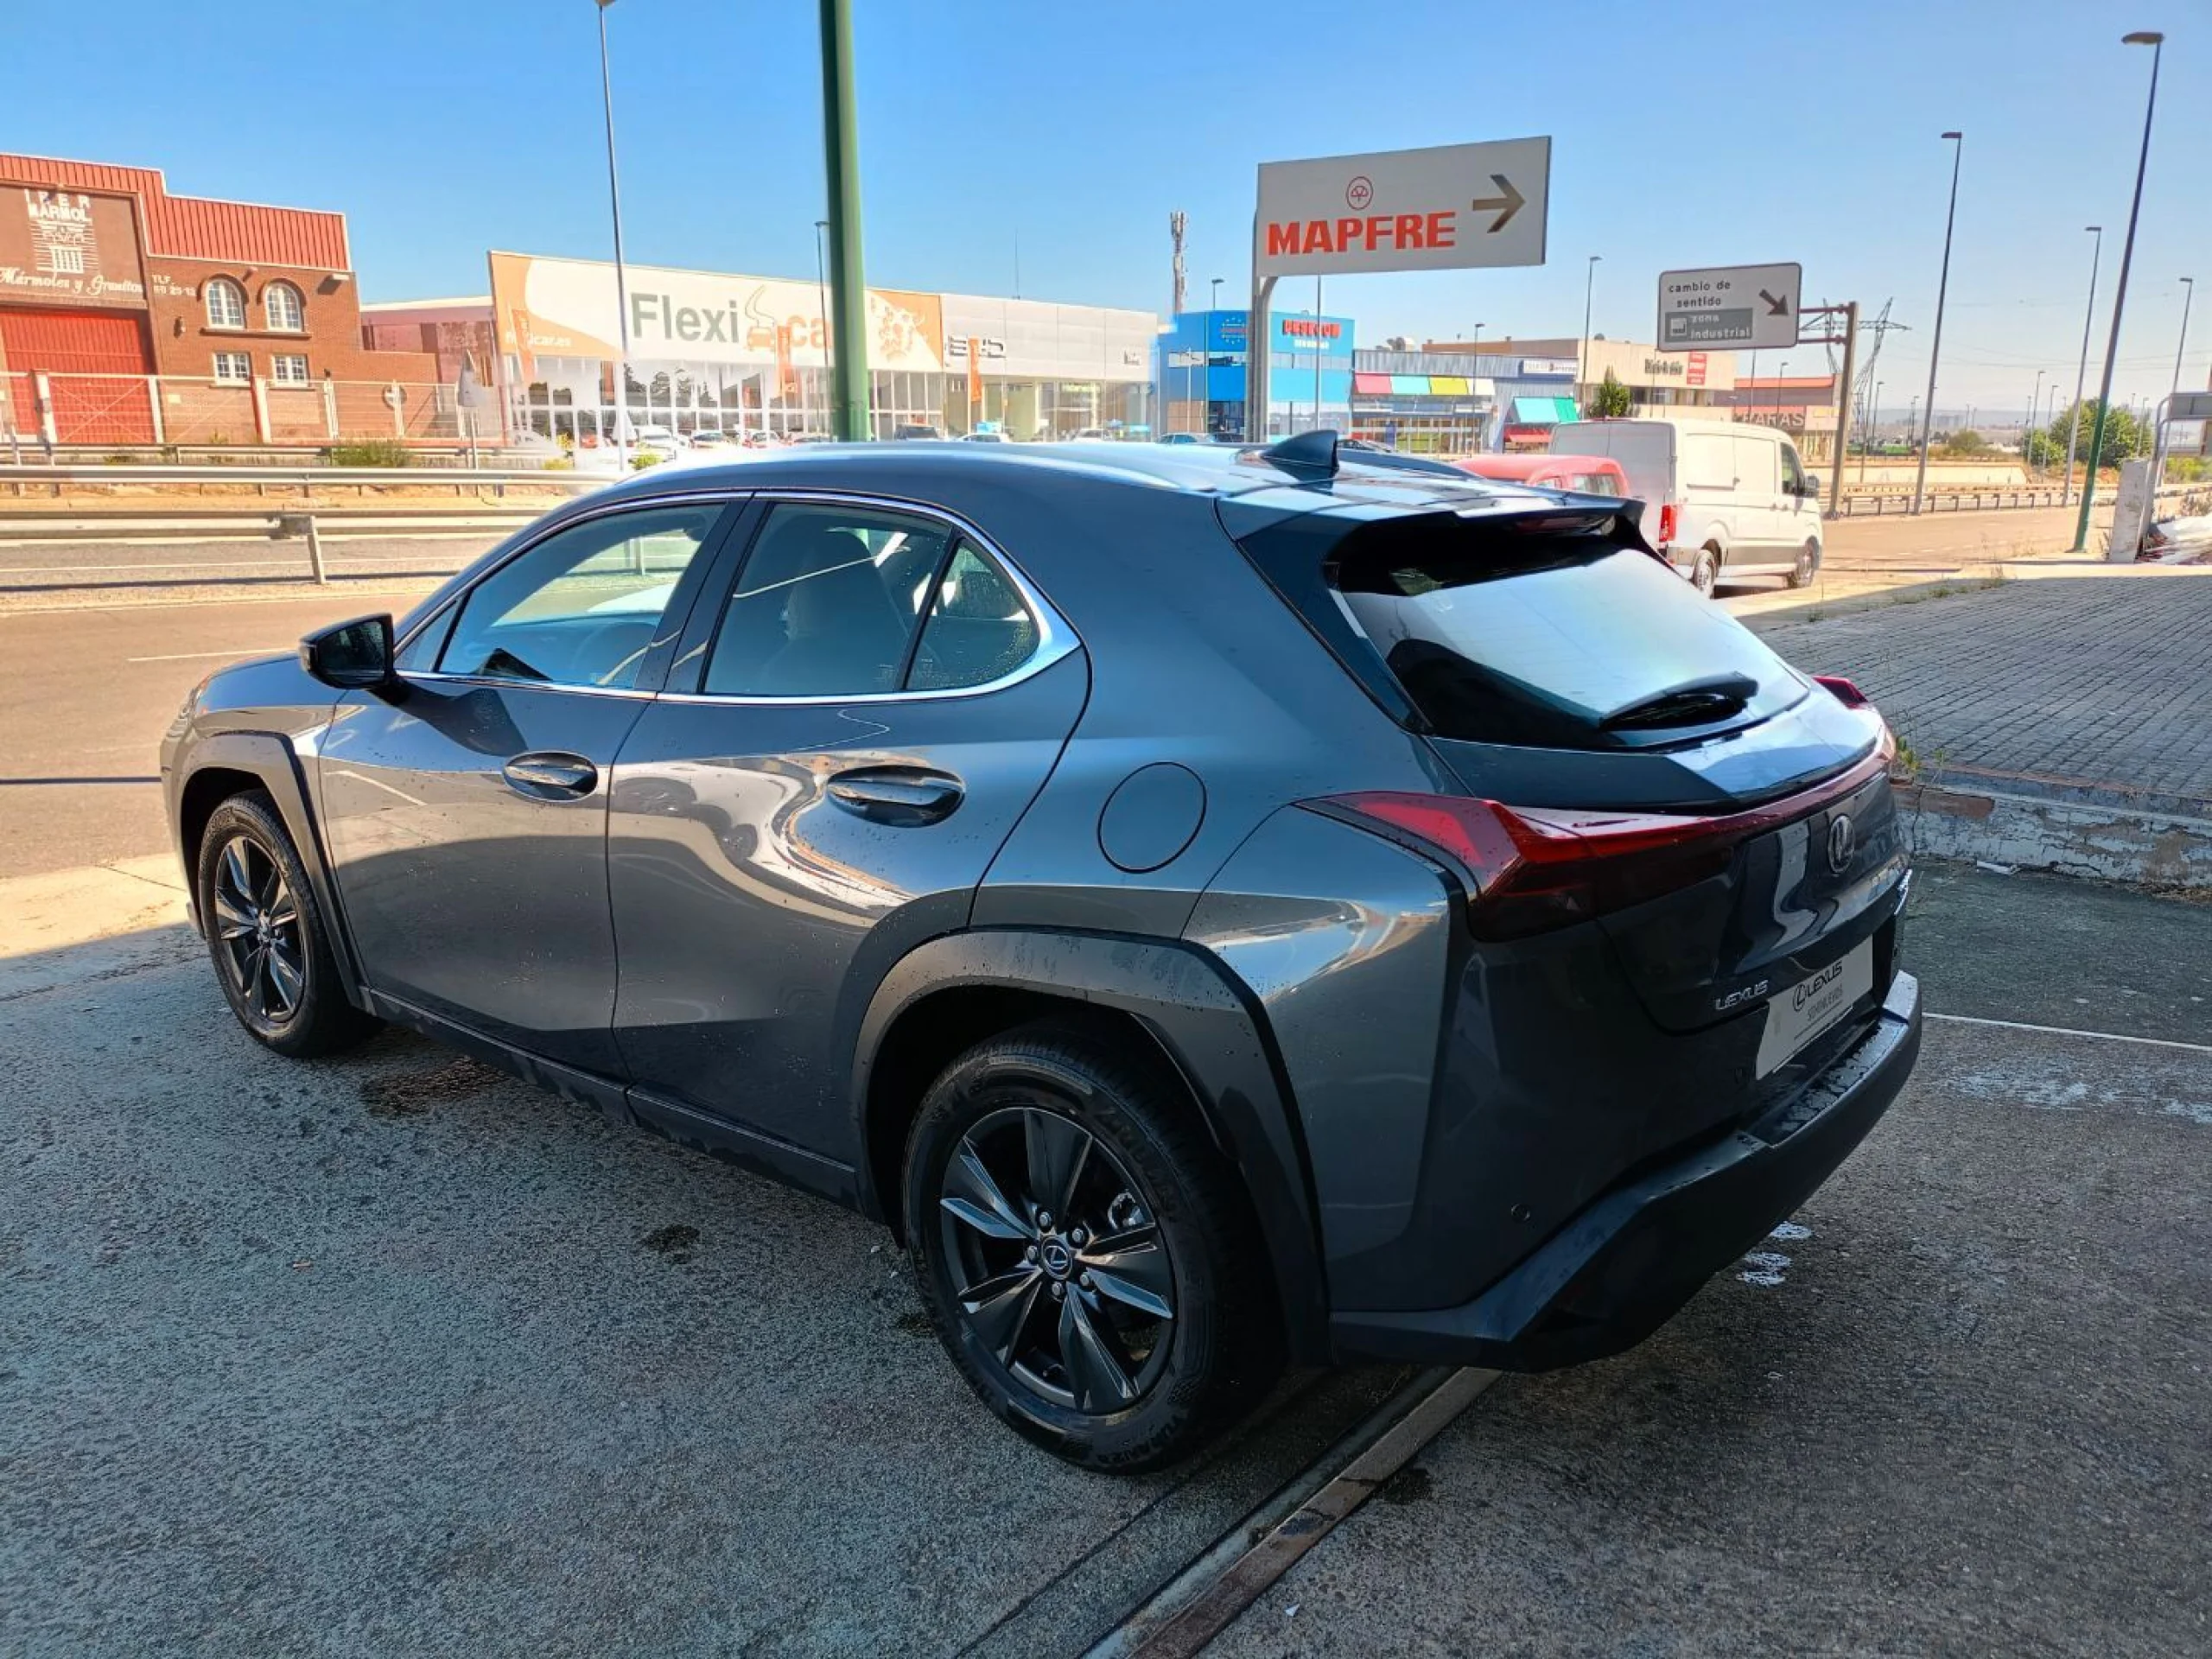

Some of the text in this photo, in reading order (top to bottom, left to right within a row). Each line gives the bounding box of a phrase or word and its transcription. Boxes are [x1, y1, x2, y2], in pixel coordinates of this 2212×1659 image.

[1268, 211, 1457, 257] MAPFRE
[1669, 280, 1731, 293] cambio de
[1676, 296, 1721, 308] sentido
[631, 292, 740, 344] Flexi
[1691, 314, 1719, 325] zona
[1691, 327, 1751, 340] industrial
[1808, 960, 1842, 997] LEXUS
[1715, 980, 1769, 1010] LEXUS
